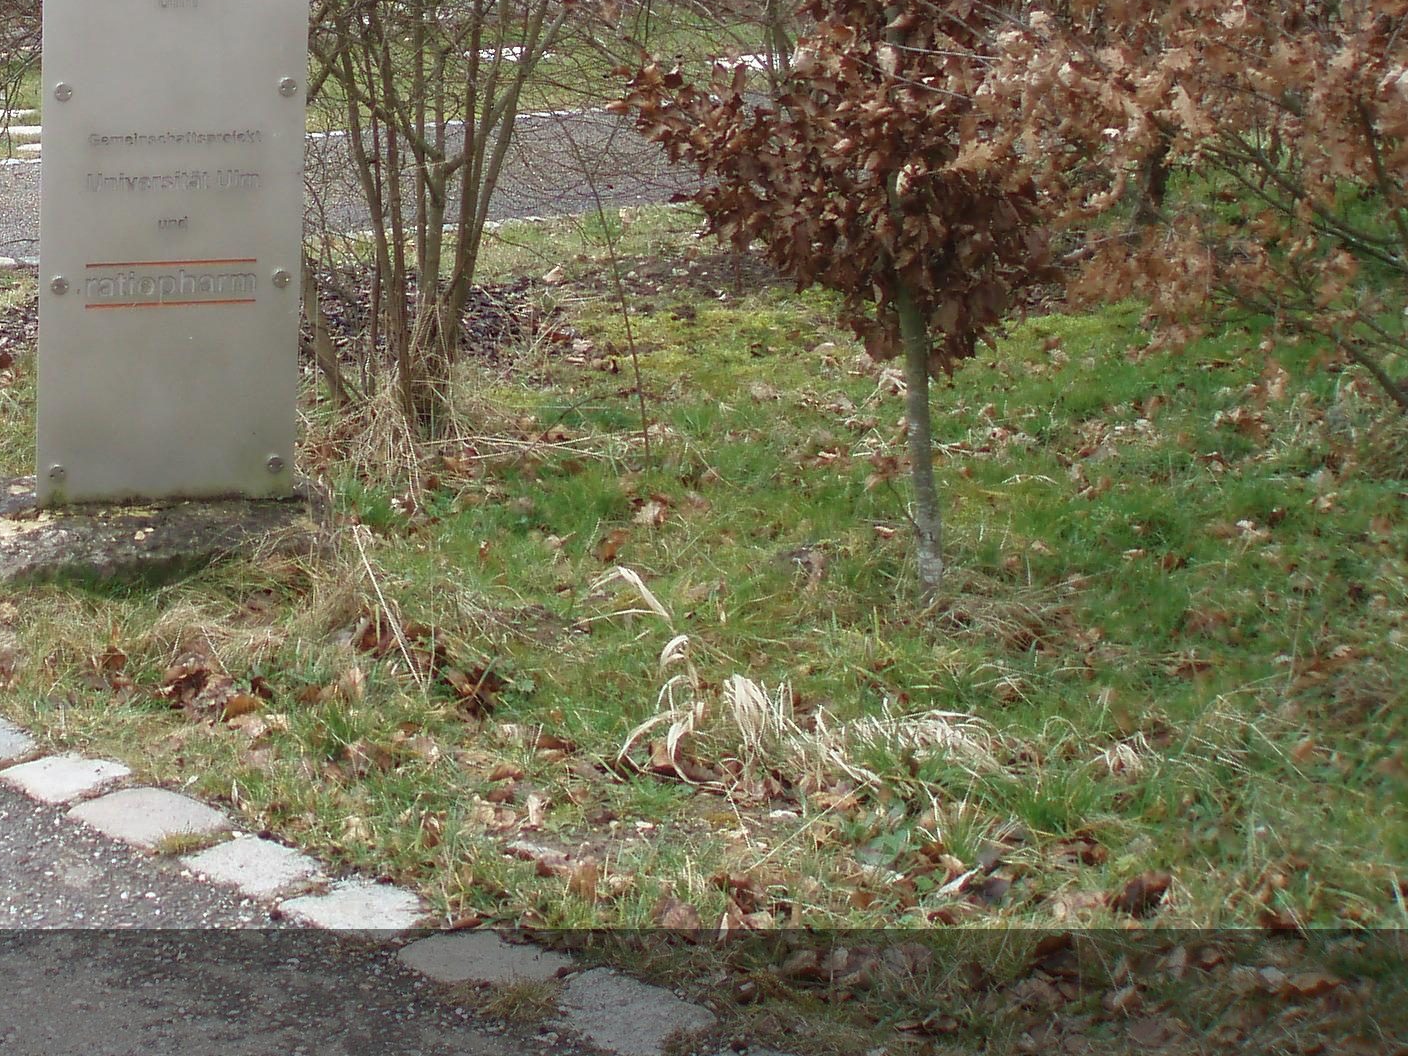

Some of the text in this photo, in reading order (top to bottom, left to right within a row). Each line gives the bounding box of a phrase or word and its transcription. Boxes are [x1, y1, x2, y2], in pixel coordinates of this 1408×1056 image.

[86, 169, 260, 192] Universität Ulm
[158, 216, 188, 232] und
[85, 269, 257, 302] ratiopharm
